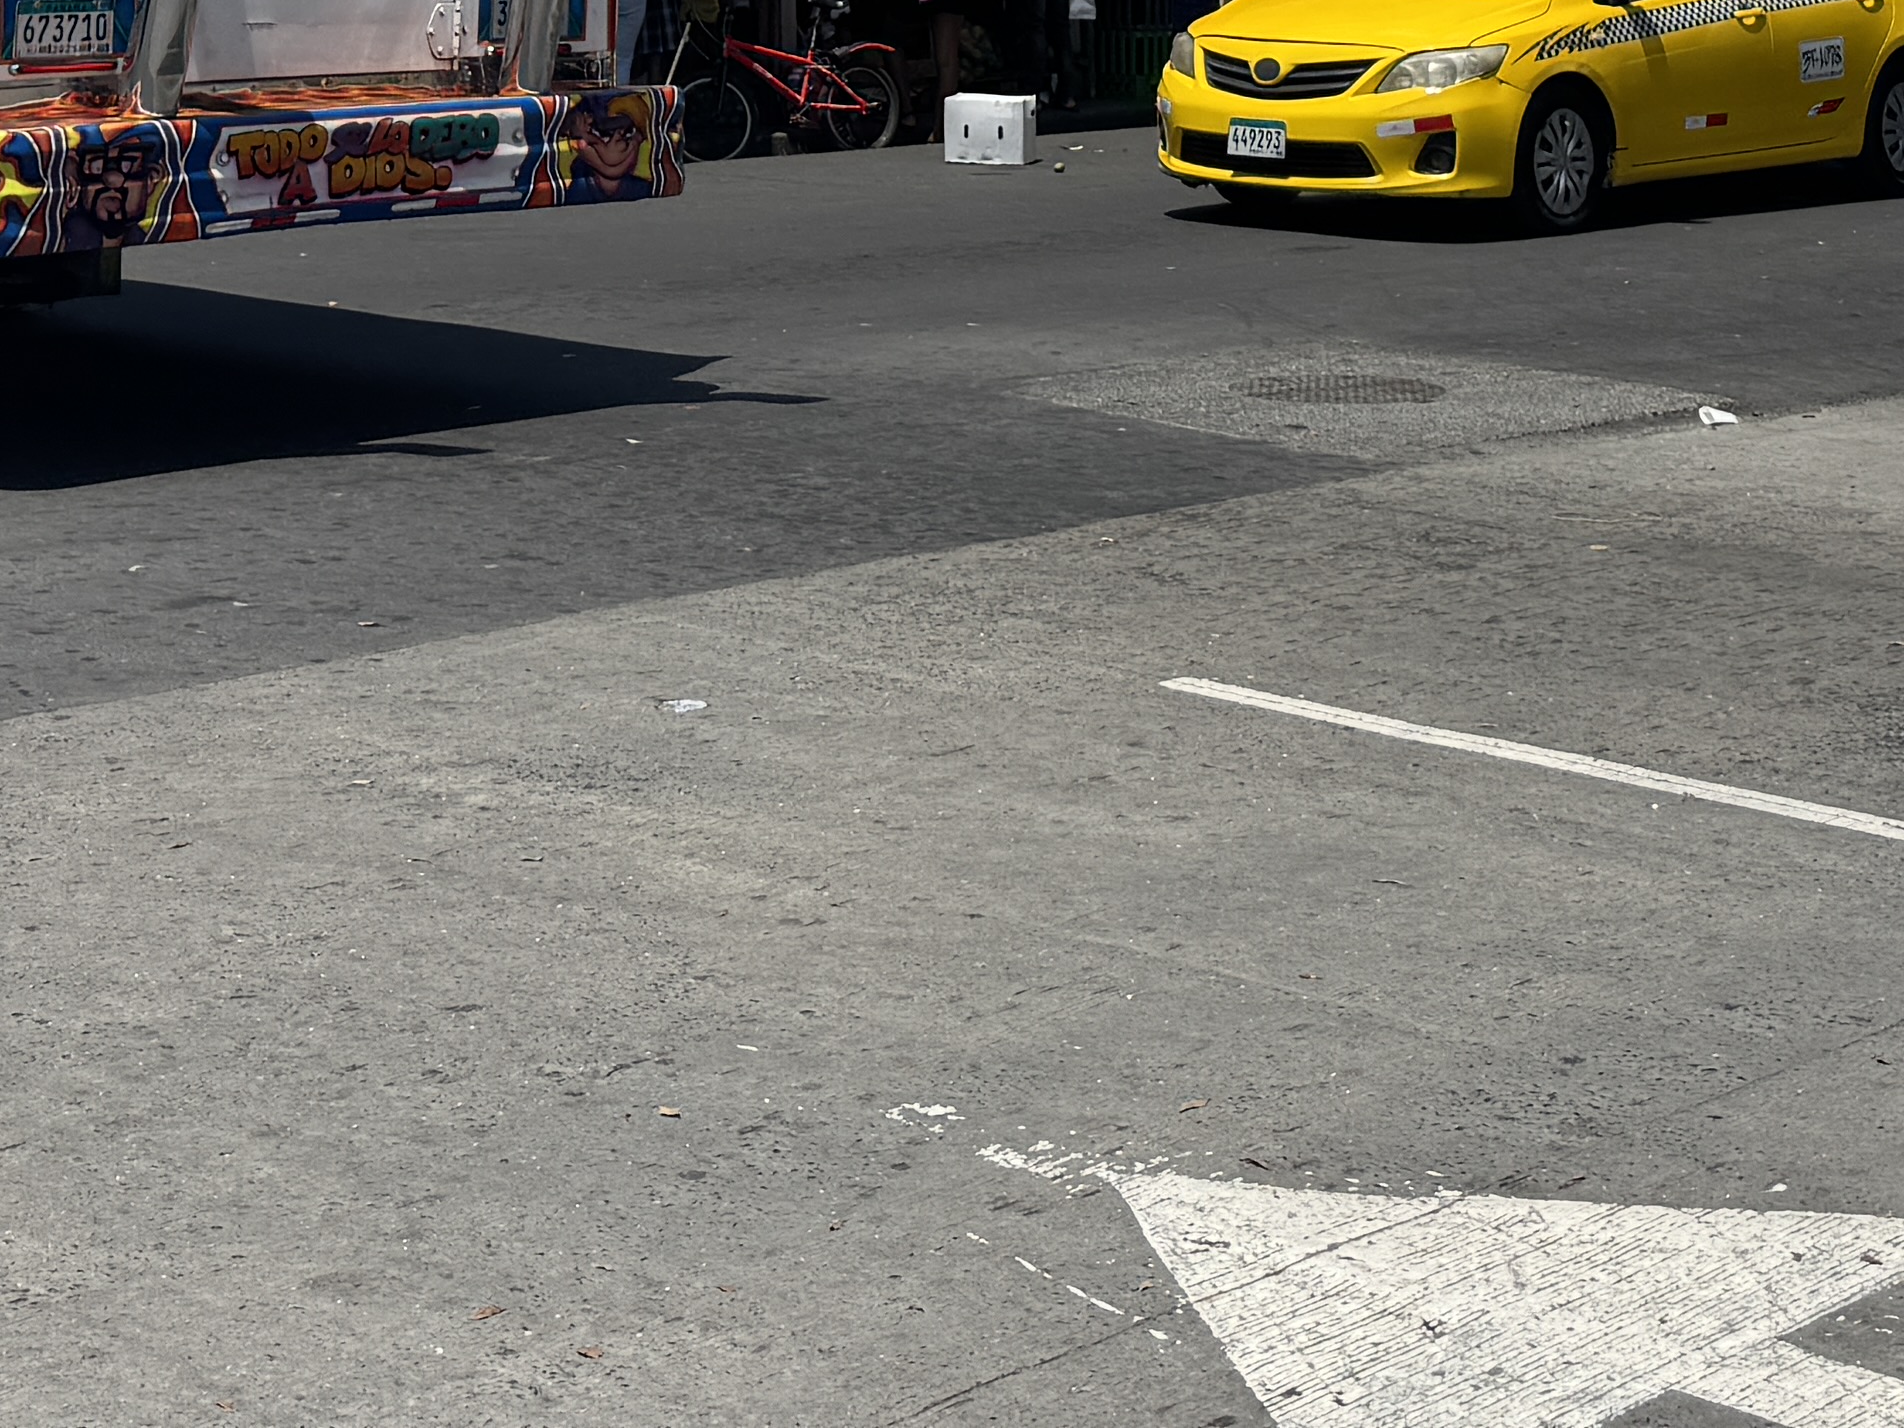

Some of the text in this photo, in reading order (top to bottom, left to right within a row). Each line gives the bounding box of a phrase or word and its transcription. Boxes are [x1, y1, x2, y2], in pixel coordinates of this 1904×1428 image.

[23, 13, 108, 44] 673710
[227, 123, 329, 179] TODO
[1232, 127, 1282, 152] 449293
[277, 161, 318, 206] A
